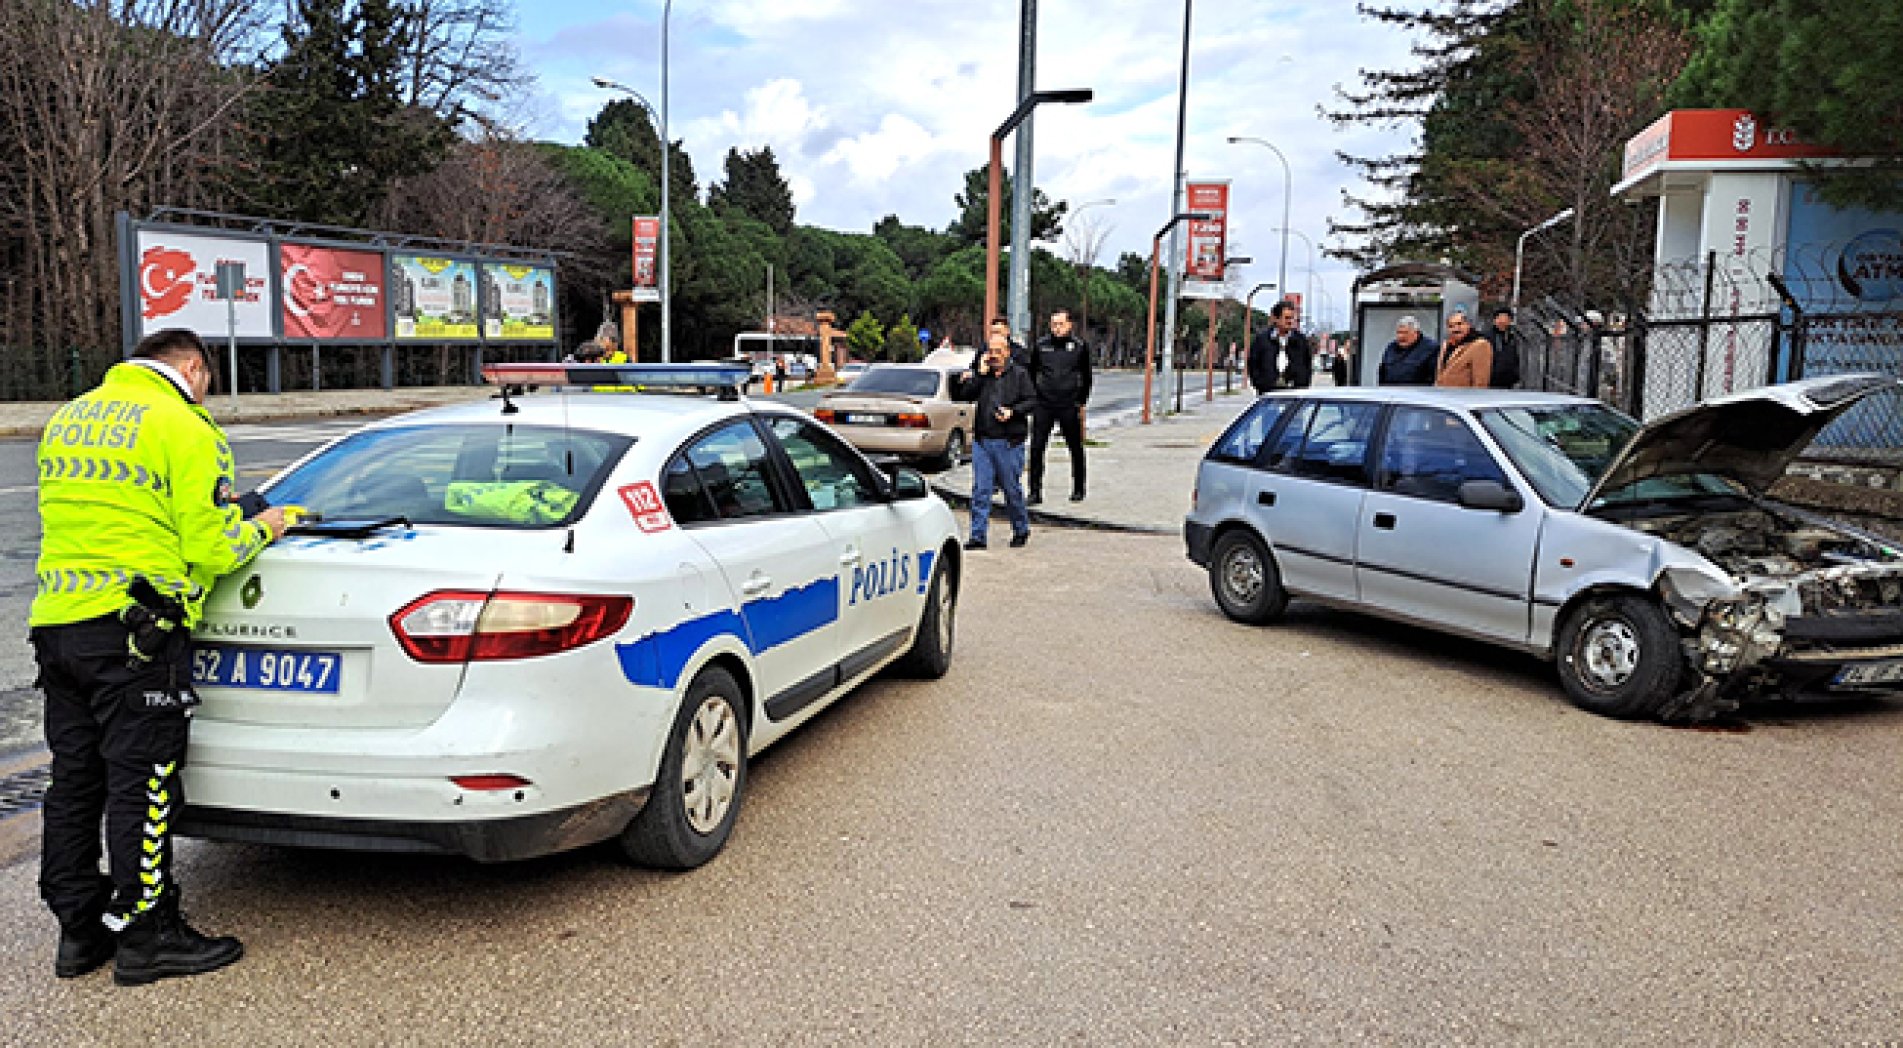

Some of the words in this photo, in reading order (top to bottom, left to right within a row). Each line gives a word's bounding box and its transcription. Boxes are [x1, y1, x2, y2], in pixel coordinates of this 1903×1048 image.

[60, 400, 150, 424] TRAFİK
[47, 424, 138, 449] POLİSİ
[626, 488, 657, 512] 112
[849, 546, 910, 606] POLİS
[193, 649, 221, 682] 52
[231, 652, 246, 683] A
[259, 652, 334, 689] 9047
